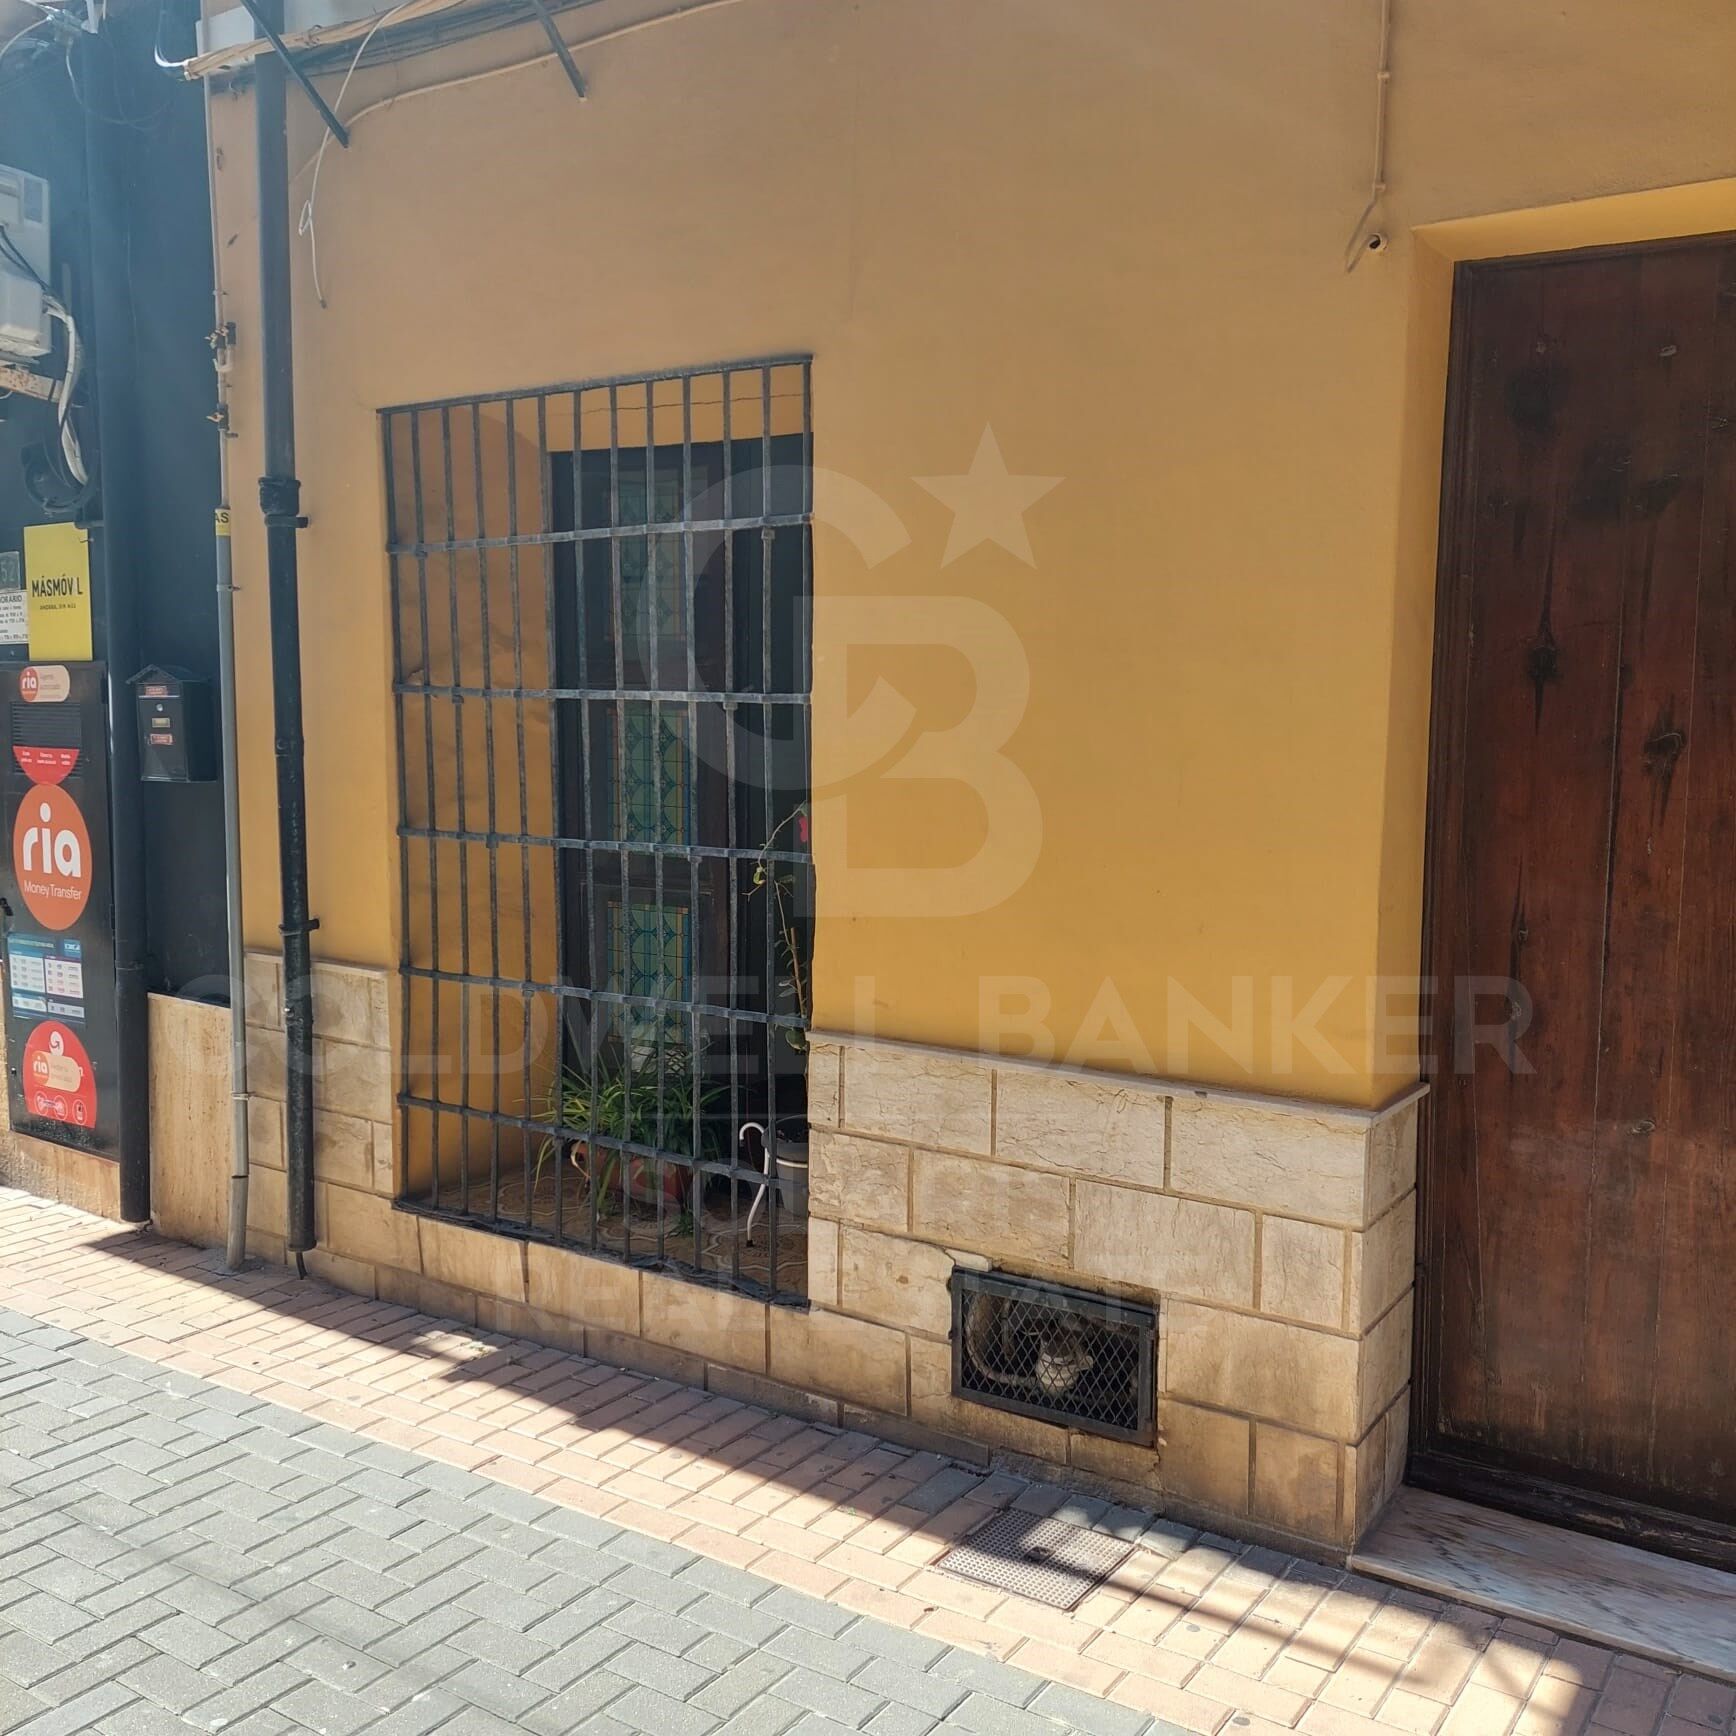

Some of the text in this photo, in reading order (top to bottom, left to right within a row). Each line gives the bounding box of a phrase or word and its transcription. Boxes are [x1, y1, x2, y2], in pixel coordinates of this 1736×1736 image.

[31, 573, 84, 598] MÁSMÓVL
[23, 802, 82, 878] ria
[24, 880, 82, 900] Money Transfer
